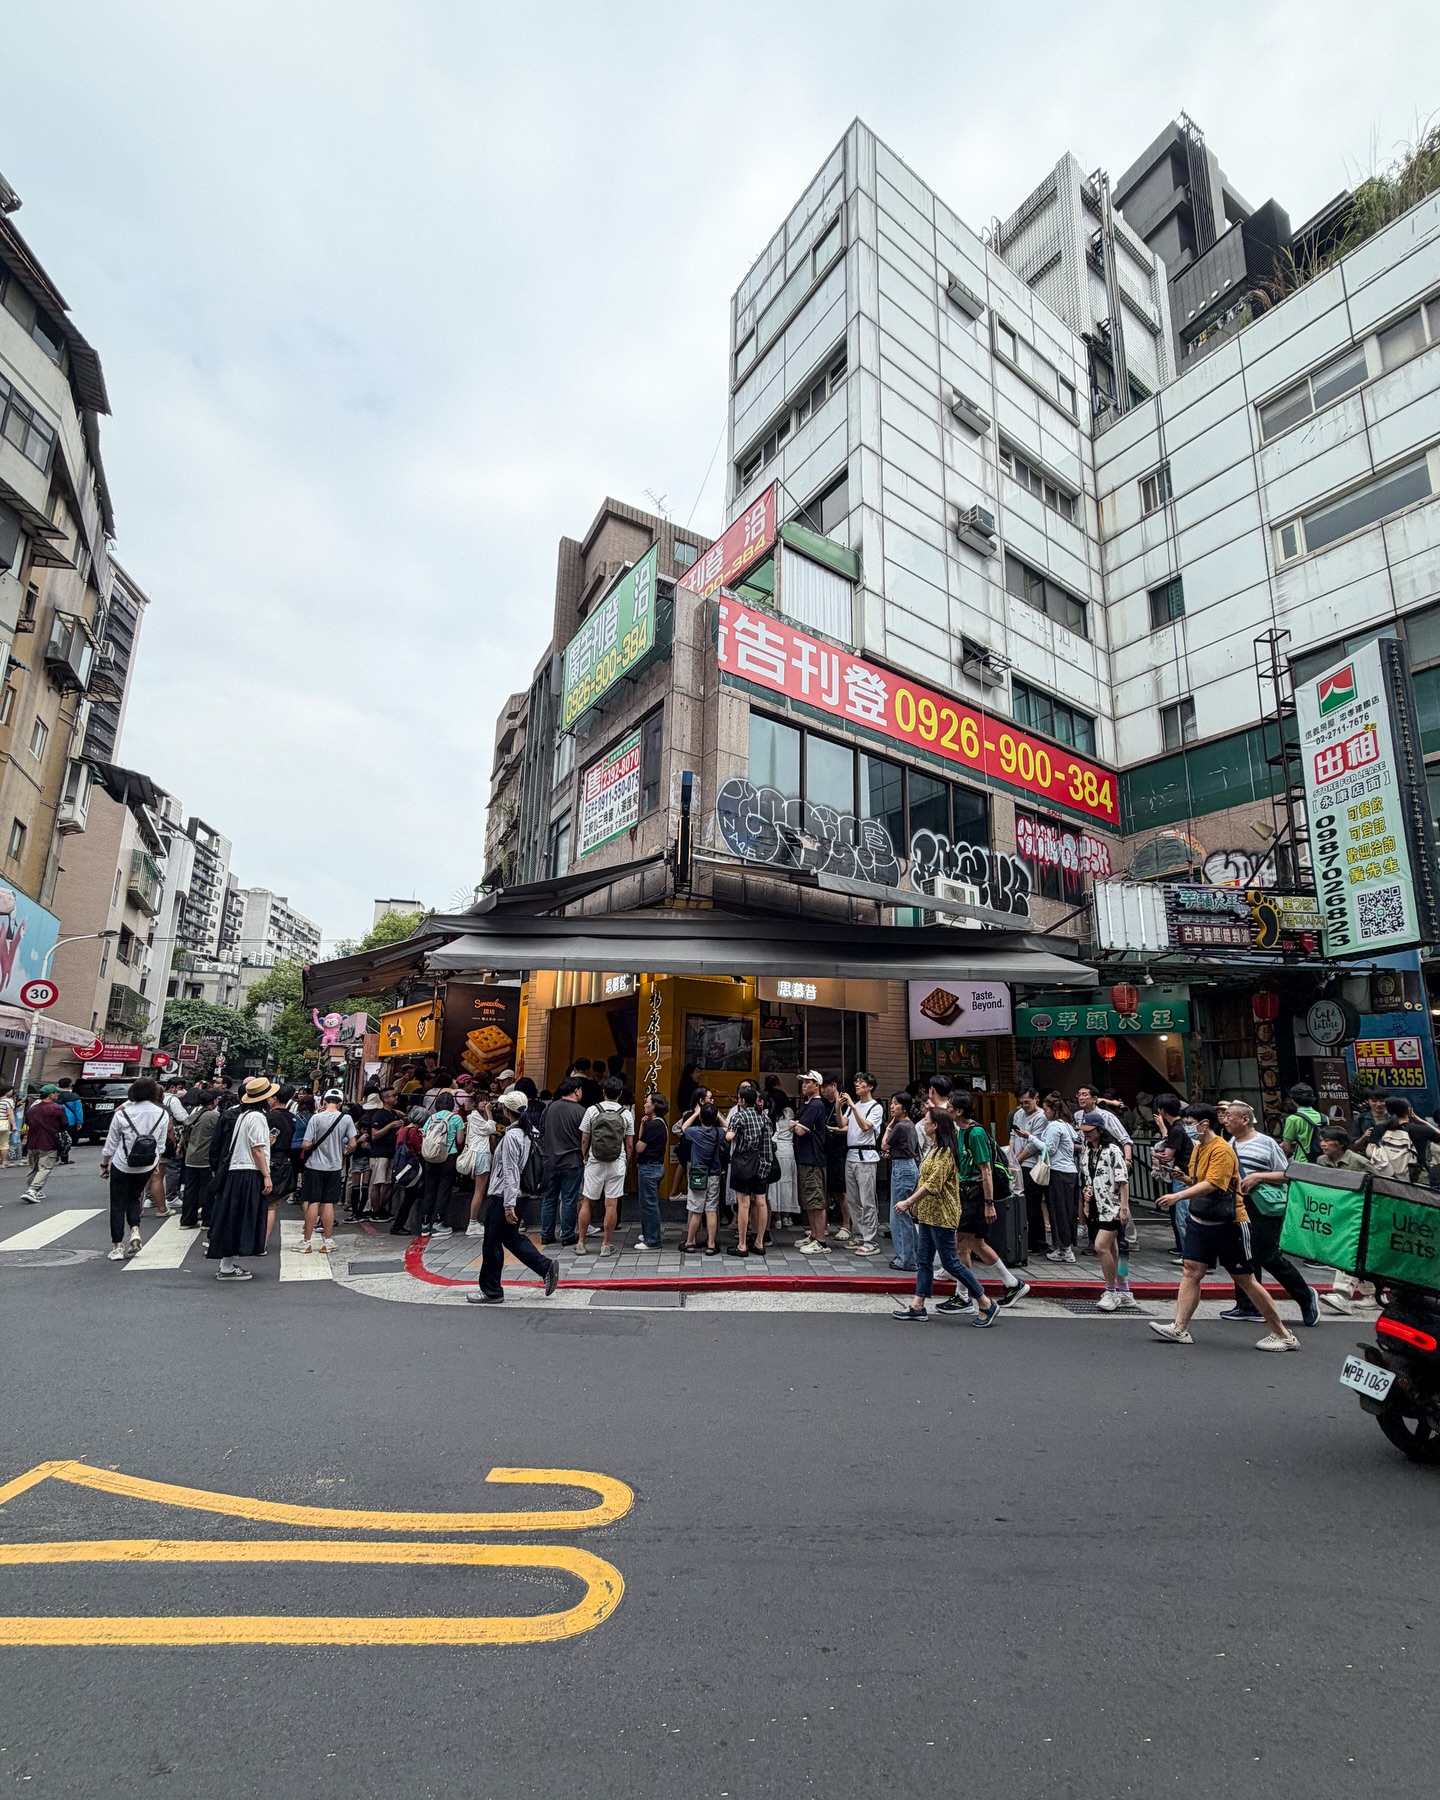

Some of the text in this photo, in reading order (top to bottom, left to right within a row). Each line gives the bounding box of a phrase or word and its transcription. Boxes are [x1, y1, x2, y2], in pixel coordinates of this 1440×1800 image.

[744, 501, 766, 547] 洽
[567, 561, 651, 691] 廣告刊登 洽
[565, 616, 647, 724] 0926-900-384
[1305, 718, 1335, 740] 信義房屋
[1315, 712, 1370, 745] 02-2711-7676
[894, 688, 1114, 814] 0926-900-384
[1315, 731, 1378, 783] 出租
[602, 748, 639, 788] 2392-8070
[1313, 761, 1387, 798] STORE FOR LEASE
[1347, 797, 1384, 822] 可餐飲
[1349, 817, 1386, 841] 可登記
[1346, 836, 1396, 864] 歡迎洽詢
[1315, 815, 1351, 947] 0987026823
[1348, 857, 1400, 885] 黃先生
[1179, 890, 1240, 909] 芋頭大王
[30, 988, 49, 1000] 30
[777, 981, 817, 1001] 思慕昔
[971, 991, 995, 1001] Taste.
[972, 998, 1005, 1012] Beyond.
[1314, 1007, 1337, 1022] Café
[765, 1019, 783, 1028] 222
[1356, 1041, 1393, 1057] 租
[1304, 1195, 1333, 1216] Uber
[1300, 1214, 1333, 1236] Eats
[1390, 1233, 1436, 1260] Eats
[1343, 1363, 1389, 1392] MPB-1069
